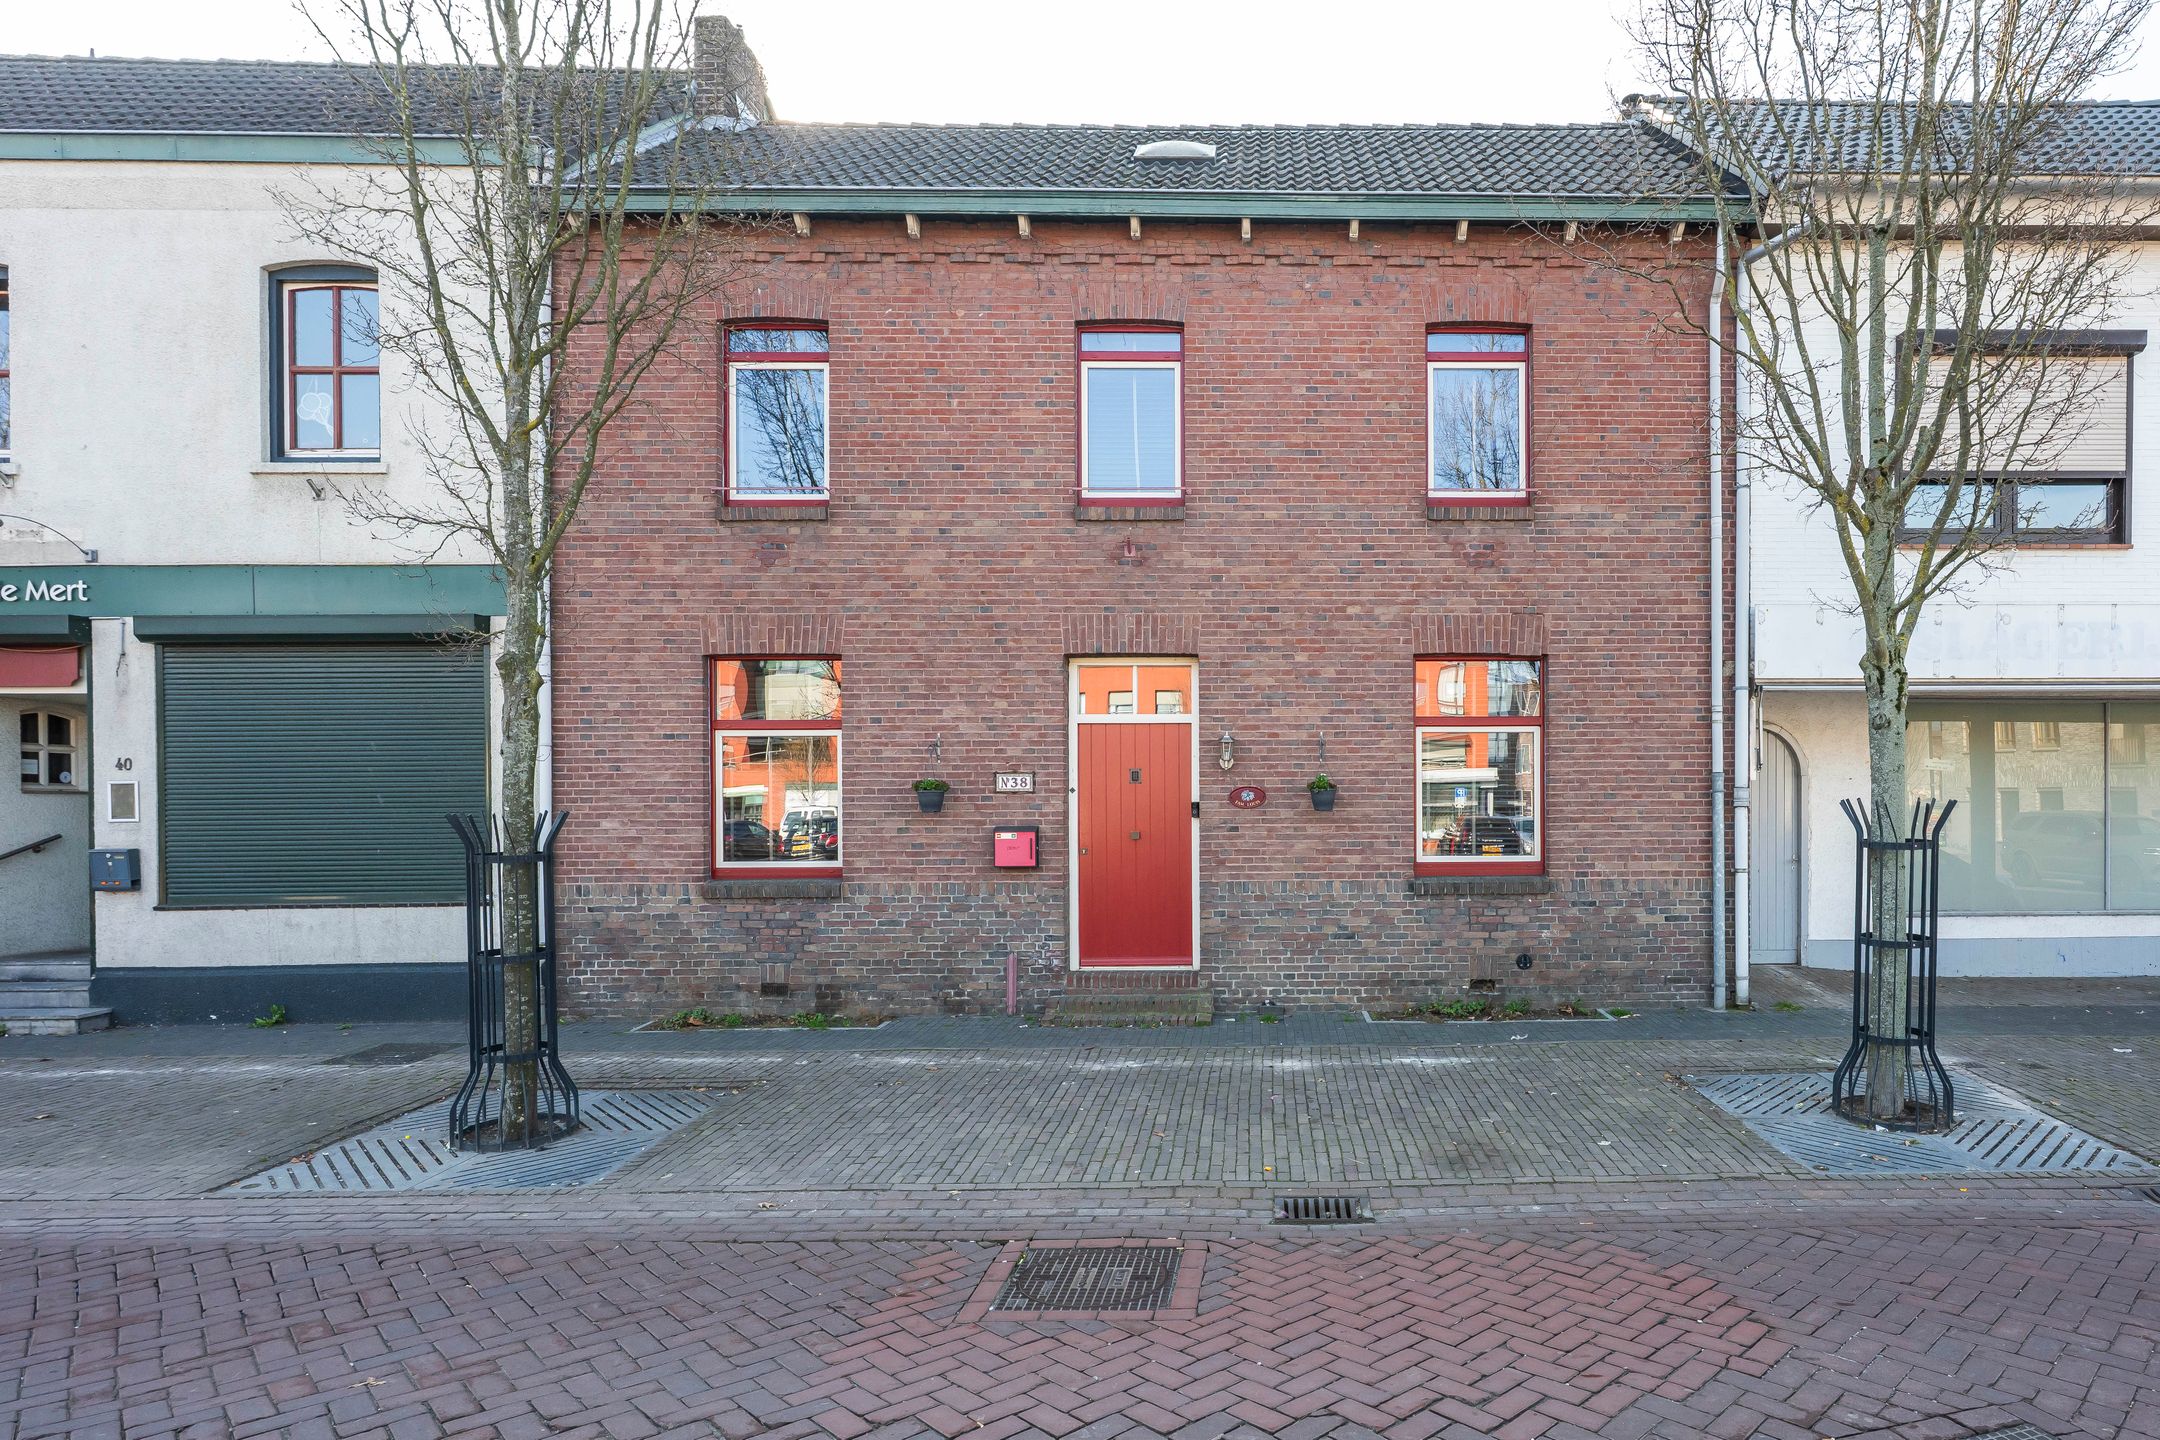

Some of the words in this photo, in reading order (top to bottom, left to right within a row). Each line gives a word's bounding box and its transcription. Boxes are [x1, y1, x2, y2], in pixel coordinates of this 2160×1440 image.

[25, 580, 88, 602] Mert
[1910, 621, 2160, 661] SLAGERI
[115, 757, 133, 771] 40
